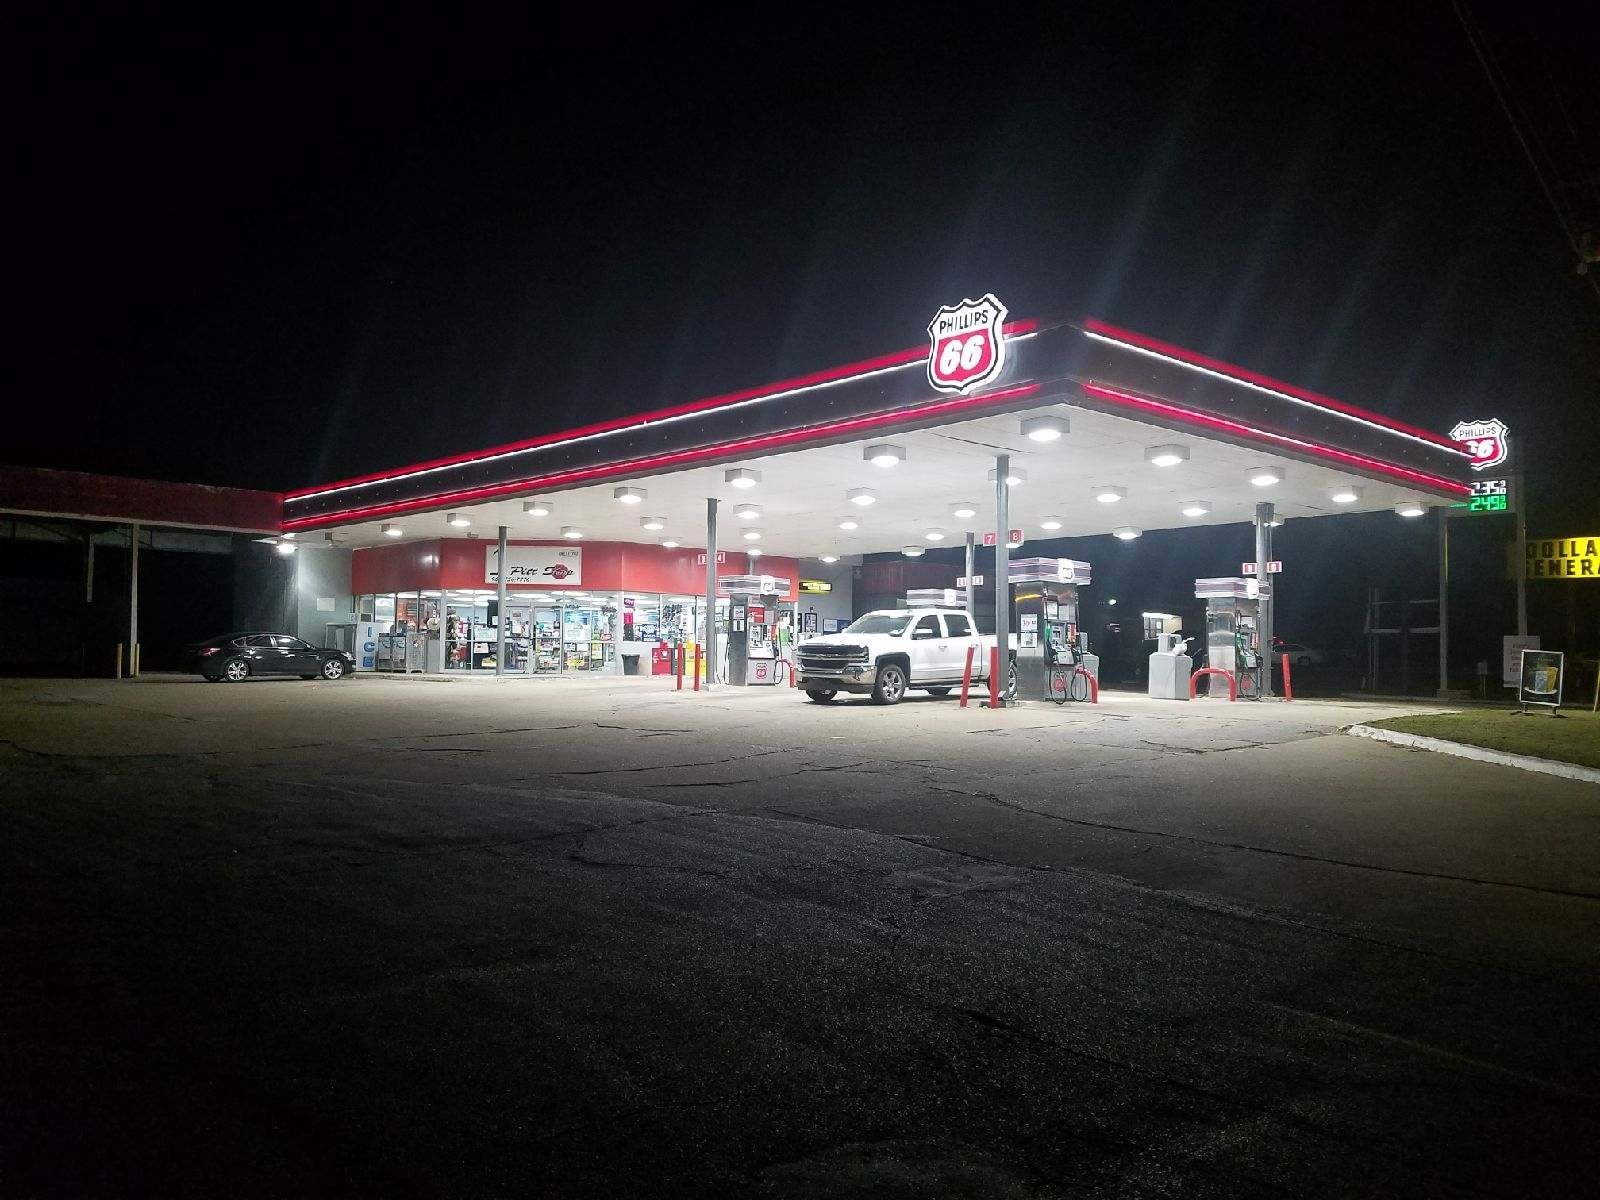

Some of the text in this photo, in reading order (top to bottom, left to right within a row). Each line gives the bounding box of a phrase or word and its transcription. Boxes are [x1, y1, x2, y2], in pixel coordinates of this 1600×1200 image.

[940, 310, 989, 334] PHILLIPS
[940, 334, 985, 375] 66
[1460, 427, 1496, 437] PHILLIPS
[1526, 559, 1600, 576] ENER
